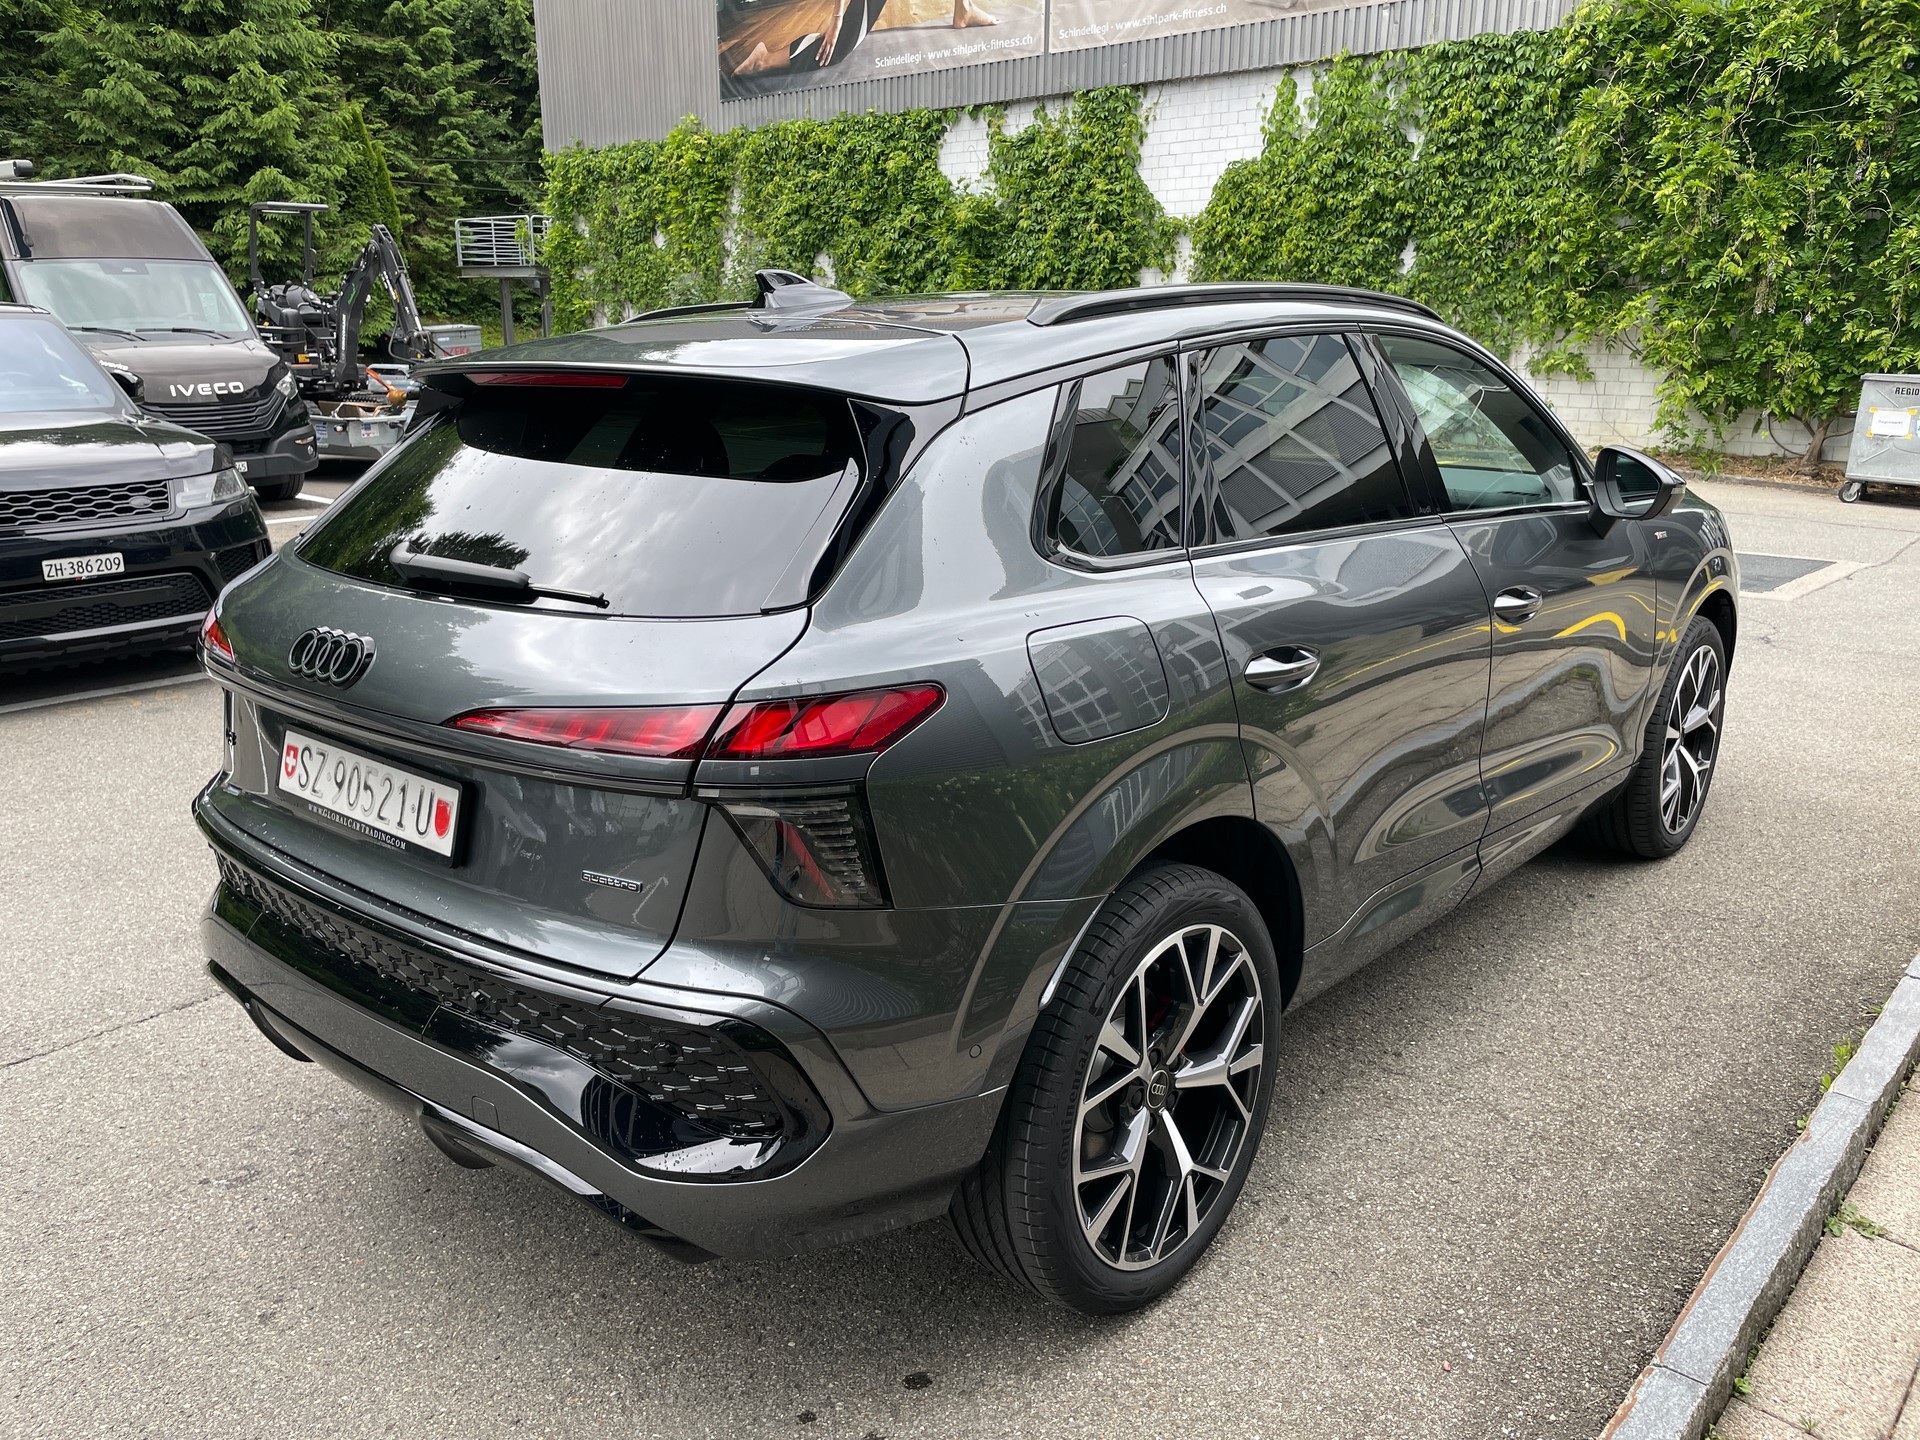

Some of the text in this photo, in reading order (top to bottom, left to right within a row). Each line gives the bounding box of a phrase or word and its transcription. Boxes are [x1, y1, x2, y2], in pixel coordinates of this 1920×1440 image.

[1059, 3, 1227, 39] Schindellegi www.sihlpark-fitness.ch
[875, 33, 1033, 69] Schindellegi www.sihlpark-fitness.ch
[169, 381, 245, 397] IVECO
[95, 557, 121, 573] 209
[582, 873, 637, 890] quattro
